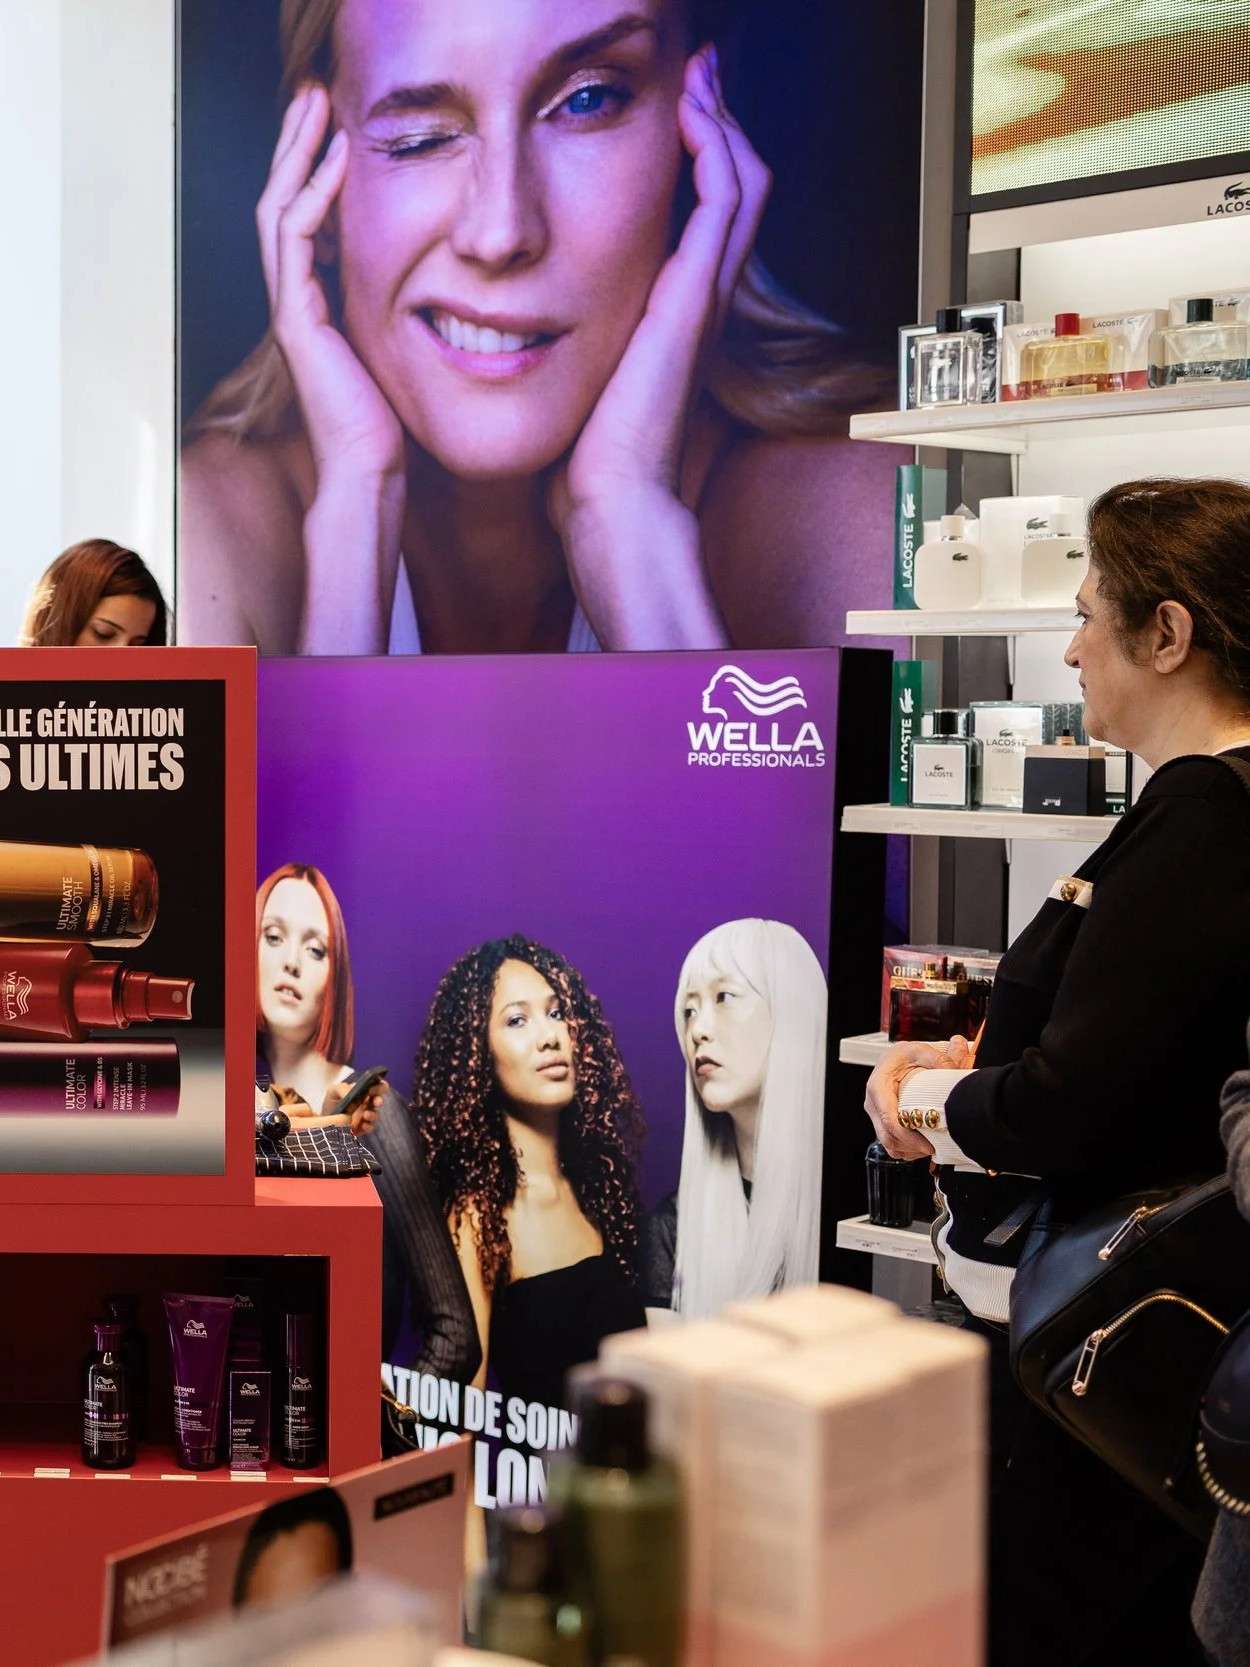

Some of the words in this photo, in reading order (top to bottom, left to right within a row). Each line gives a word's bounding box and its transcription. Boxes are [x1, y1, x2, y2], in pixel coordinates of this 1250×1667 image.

[1093, 319, 1123, 329] LACOSTE
[902, 523, 914, 588] LACOSTE
[37, 701, 184, 737] GÉNÉRATION
[686, 722, 824, 752] WELLA
[19, 743, 185, 790] ULTIMES
[687, 752, 826, 768] PROFESSIONALS
[56, 877, 72, 930] ULTIMATE
[67, 881, 83, 930] SMOOTH
[87, 914, 95, 930] WITH
[91, 882, 100, 915] SQUALANE
[107, 885, 115, 910] MIRACLE
[6, 971, 17, 1020] WELLA
[65, 1058, 76, 1110] ULTIMATE
[76, 1074, 86, 1110] COLOR
[140, 1093, 146, 1102] ML
[174, 1385, 195, 1393] ULTIMATE
[464, 1385, 503, 1438] DE
